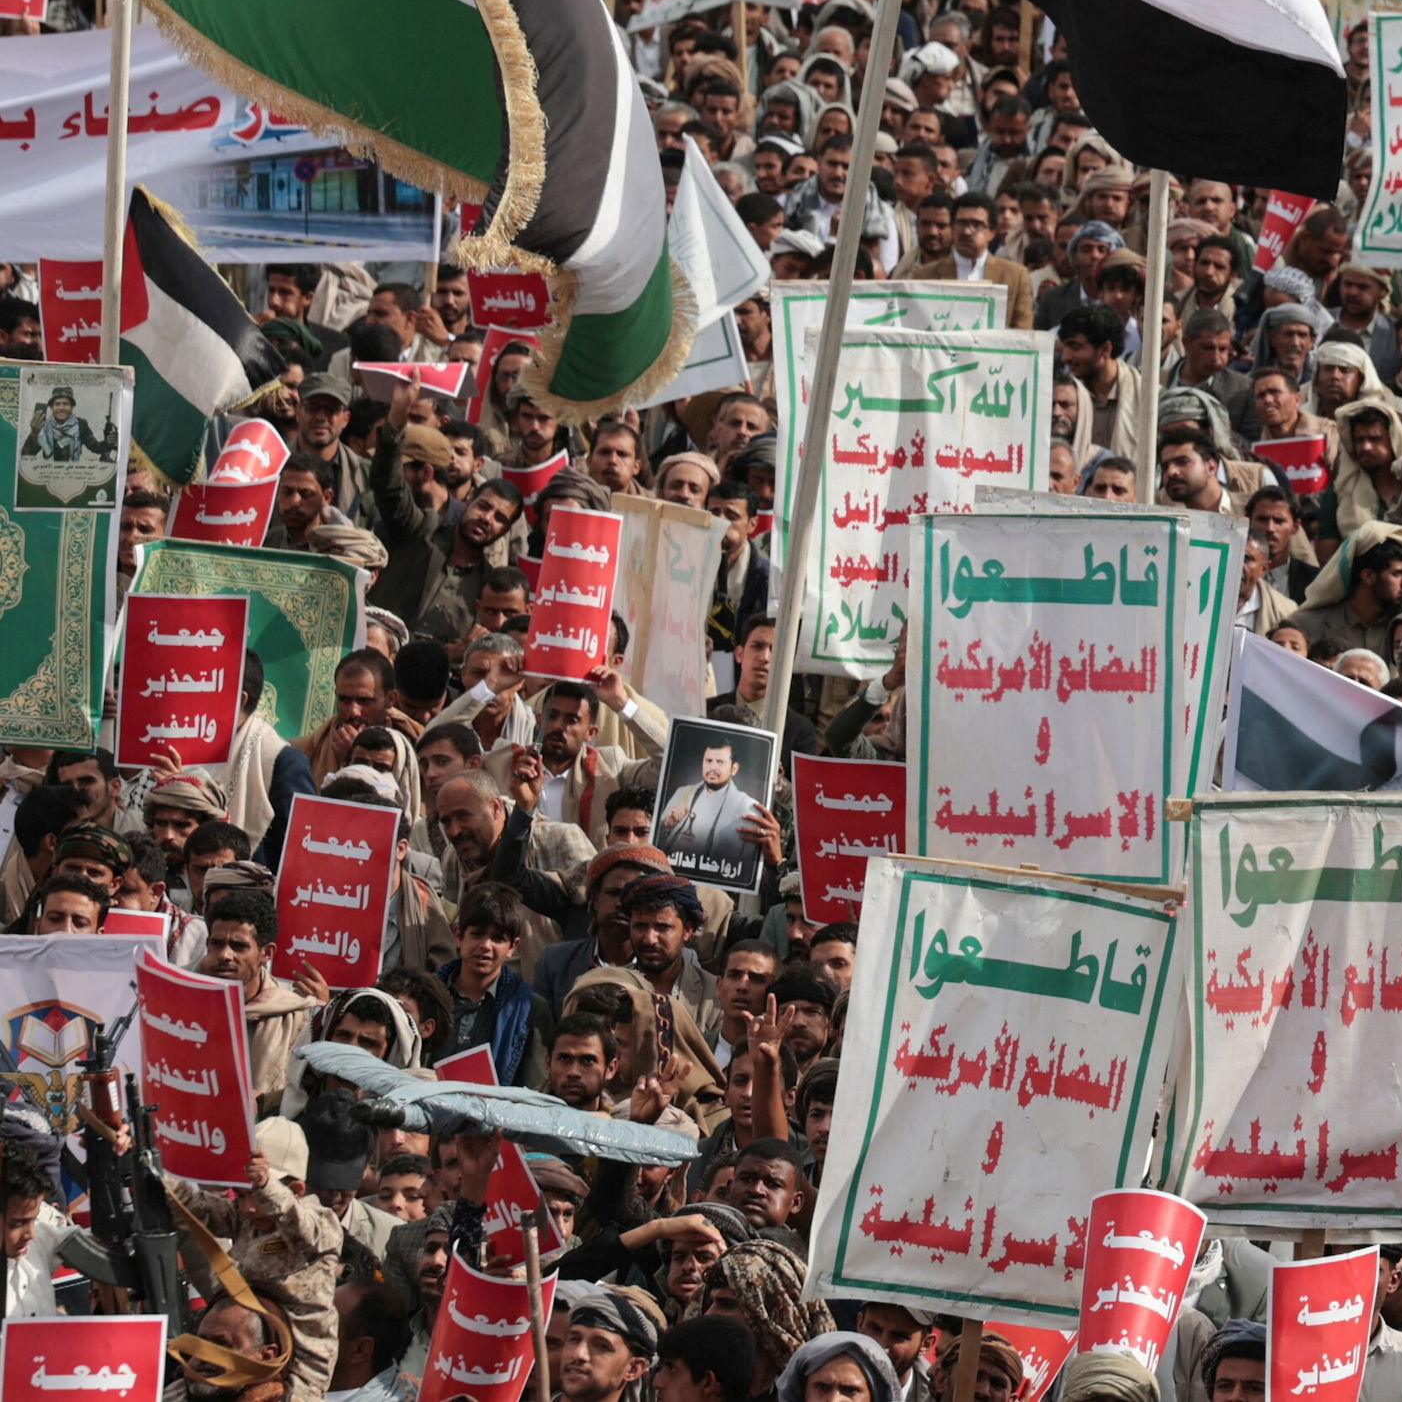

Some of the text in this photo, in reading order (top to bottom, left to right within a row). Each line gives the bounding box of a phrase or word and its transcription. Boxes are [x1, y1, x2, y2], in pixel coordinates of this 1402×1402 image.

[59, 92, 221, 139] صناء
[548, 533, 610, 569] جمعة
[530, 580, 608, 609] التحذير
[940, 542, 1158, 619] قاطعوا
[148, 621, 225, 651] جمعة
[530, 624, 600, 659] والنفير
[141, 668, 224, 697] التحذير
[1056, 641, 1158, 704] البضائع
[140, 714, 216, 743] والنفير
[1034, 717, 1052, 765] و
[302, 825, 372, 865] جمعة
[699, 855, 742, 878] ارواحنا
[290, 878, 369, 910] التحذير
[286, 927, 360, 963] والنفير
[909, 910, 1150, 1015] قاطعوا
[140, 992, 208, 1045] جمعة
[145, 1059, 221, 1098] التحذير
[1017, 1042, 1127, 1118] البضائع
[1307, 1030, 1328, 1094] و
[152, 1107, 226, 1154] والنفير
[981, 1124, 1000, 1174] و
[859, 1183, 1088, 1282] لإسرائيلية
